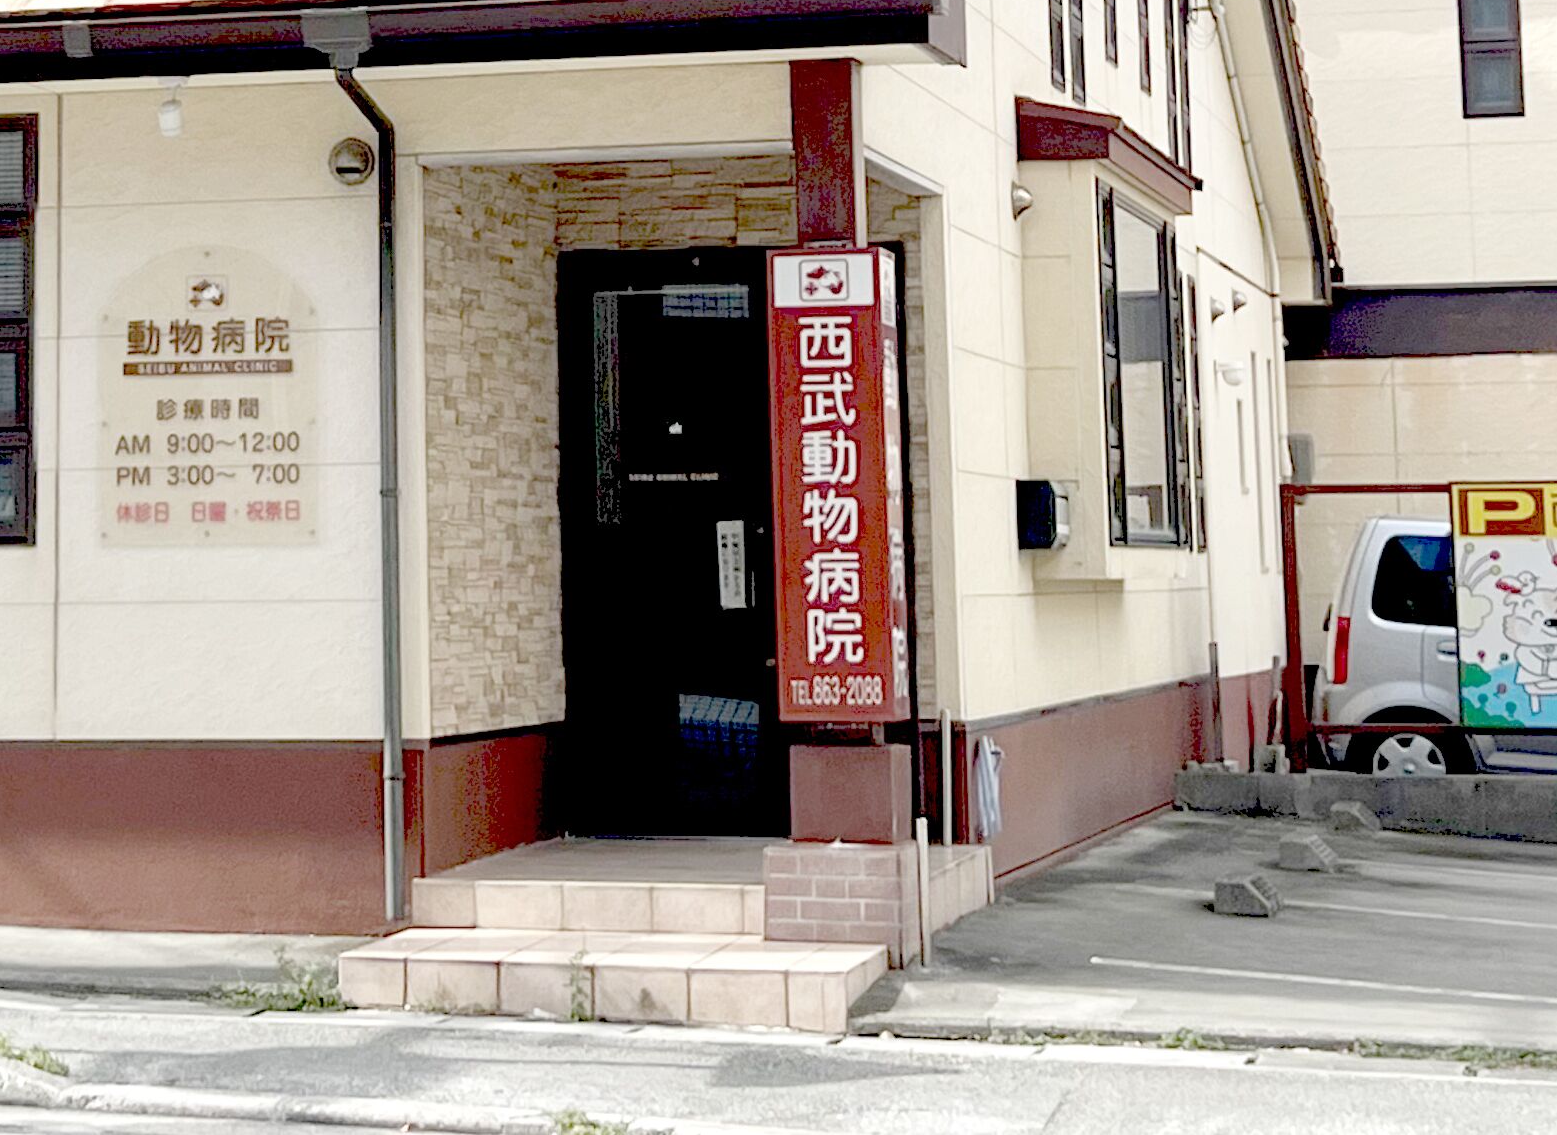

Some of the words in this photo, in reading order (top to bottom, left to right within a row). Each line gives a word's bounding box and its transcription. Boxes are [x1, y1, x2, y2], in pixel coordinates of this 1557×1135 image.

[127, 317, 290, 356] 動物病院
[138, 363, 175, 374] SEIBU
[179, 362, 228, 373] ANIMAL
[234, 361, 278, 372] CLINIC
[156, 398, 259, 421] 診療時間
[115, 435, 151, 455] AM
[116, 466, 151, 487] PM
[797, 314, 865, 666] 西武動物病院
[116, 502, 169, 523] 休診日
